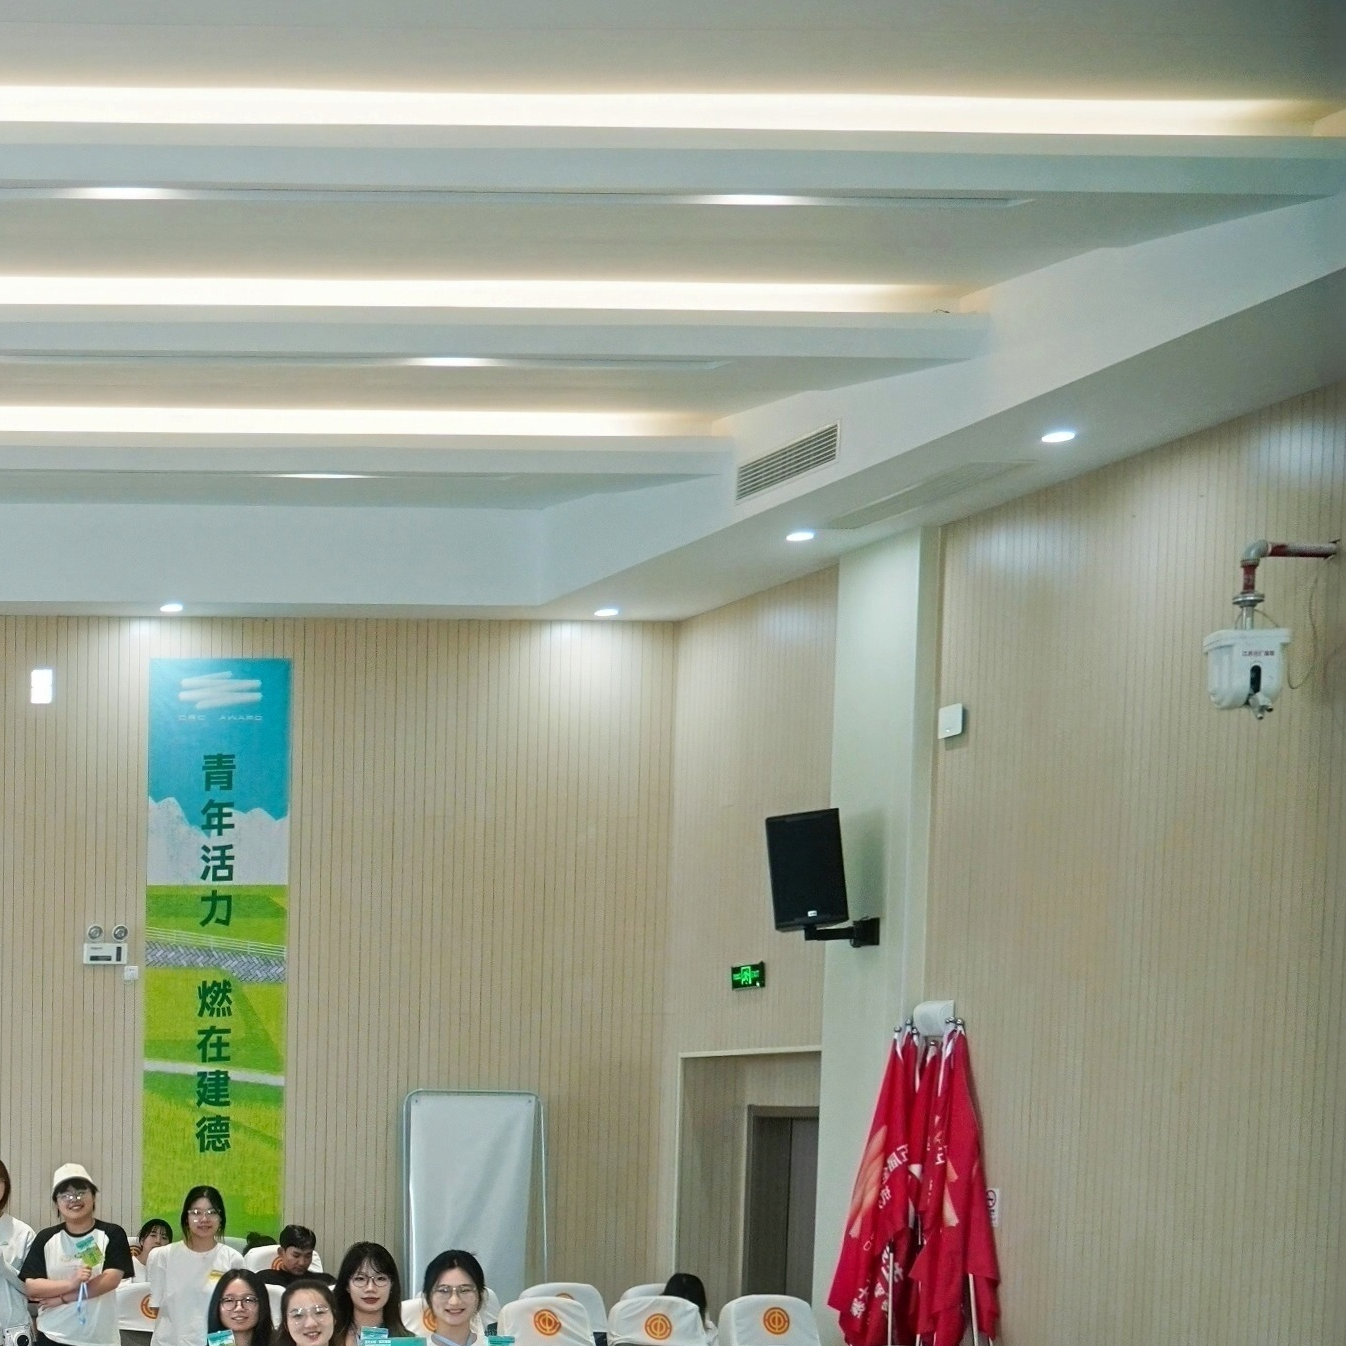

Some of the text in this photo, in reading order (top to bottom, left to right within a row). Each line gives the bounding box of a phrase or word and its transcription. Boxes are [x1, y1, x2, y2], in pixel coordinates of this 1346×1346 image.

[195, 753, 236, 1154] 青年活力 燃在建德
